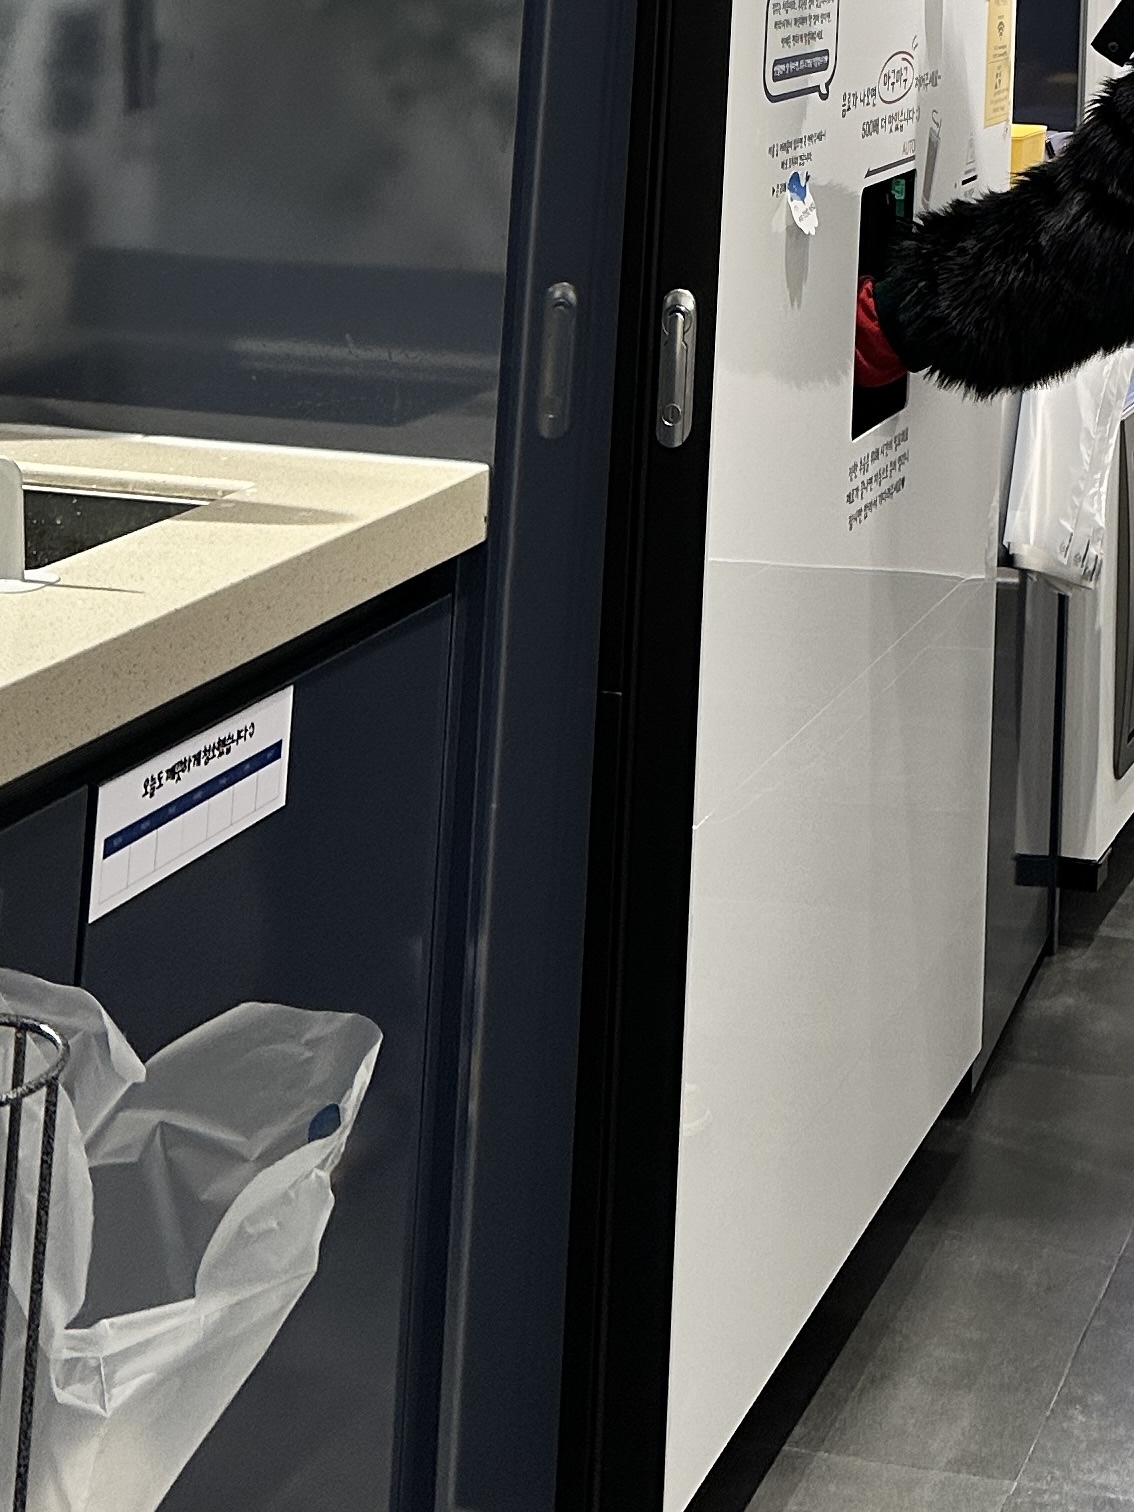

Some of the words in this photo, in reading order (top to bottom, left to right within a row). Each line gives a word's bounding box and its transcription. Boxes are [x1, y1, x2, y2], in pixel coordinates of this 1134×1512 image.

[842, 90, 859, 118] 음료가
[860, 85, 877, 107] 나오면
[883, 66, 908, 92] 마구마구
[880, 115, 887, 132] 더
[888, 107, 915, 134] 맛있습니다
[903, 138, 916, 155] AUTO
[142, 770, 164, 799] 오늘도
[165, 750, 202, 784] 깨끗하게
[202, 724, 249, 767] 청소했습니다
